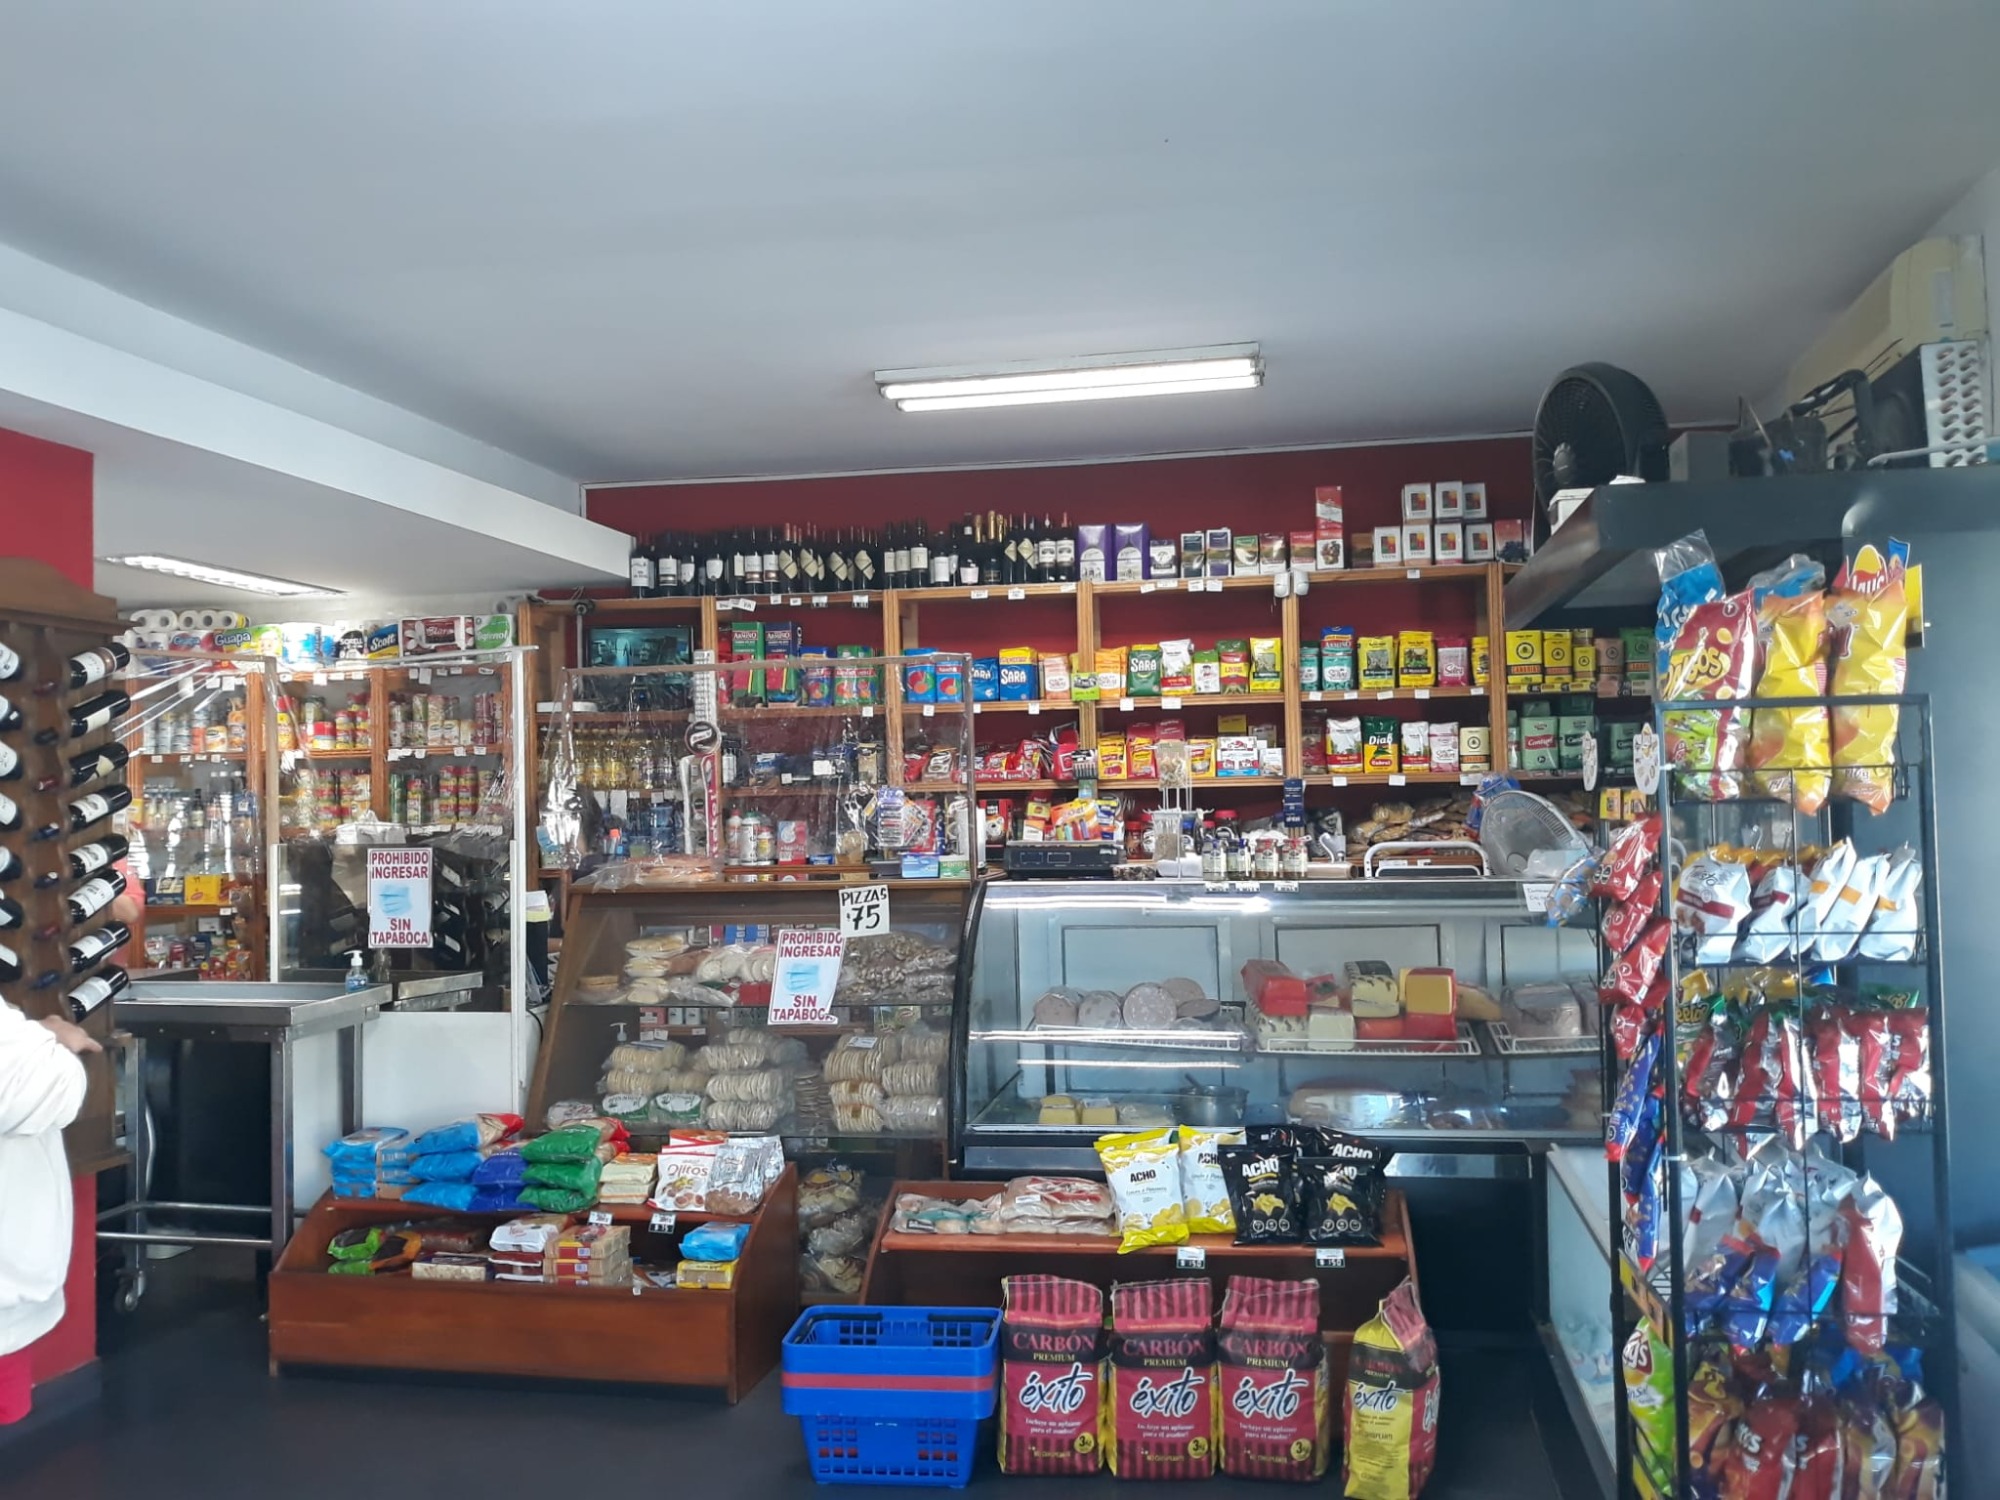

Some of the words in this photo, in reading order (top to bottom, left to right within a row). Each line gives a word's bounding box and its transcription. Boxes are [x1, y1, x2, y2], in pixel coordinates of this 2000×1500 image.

[214, 631, 251, 647] Guapa
[370, 632, 397, 651] Scott
[1130, 657, 1157, 673] SARA
[1001, 668, 1027, 685] SARA
[371, 852, 429, 865] PROHIBIDO
[371, 866, 428, 879] INGRESAR
[841, 887, 887, 906] PIZZAS
[390, 918, 411, 931] SIN
[372, 931, 428, 945] TAPABOCA
[782, 932, 842, 945] PROHIBIDO
[780, 945, 841, 958] INGRESAR
[793, 995, 817, 1008] SIN
[1331, 1143, 1373, 1159] ACHO
[1197, 1152, 1221, 1165] ACH
[1242, 1157, 1279, 1178] ACHO
[1130, 1169, 1156, 1183] ACHO
[1013, 1329, 1095, 1352] CARBÓN
[1033, 1352, 1075, 1362] PREMIUM
[1144, 1357, 1187, 1367] PREMIUM
[1246, 1357, 1289, 1368] PREMIUM
[1019, 1362, 1094, 1415] éxito
[1130, 1366, 1205, 1418] éxito
[1232, 1368, 1309, 1420] éxito
[1353, 1381, 1405, 1412] éxito
[1079, 1435, 1085, 1447] 3
[1193, 1439, 1199, 1451] 3
[1296, 1441, 1302, 1454] 3
